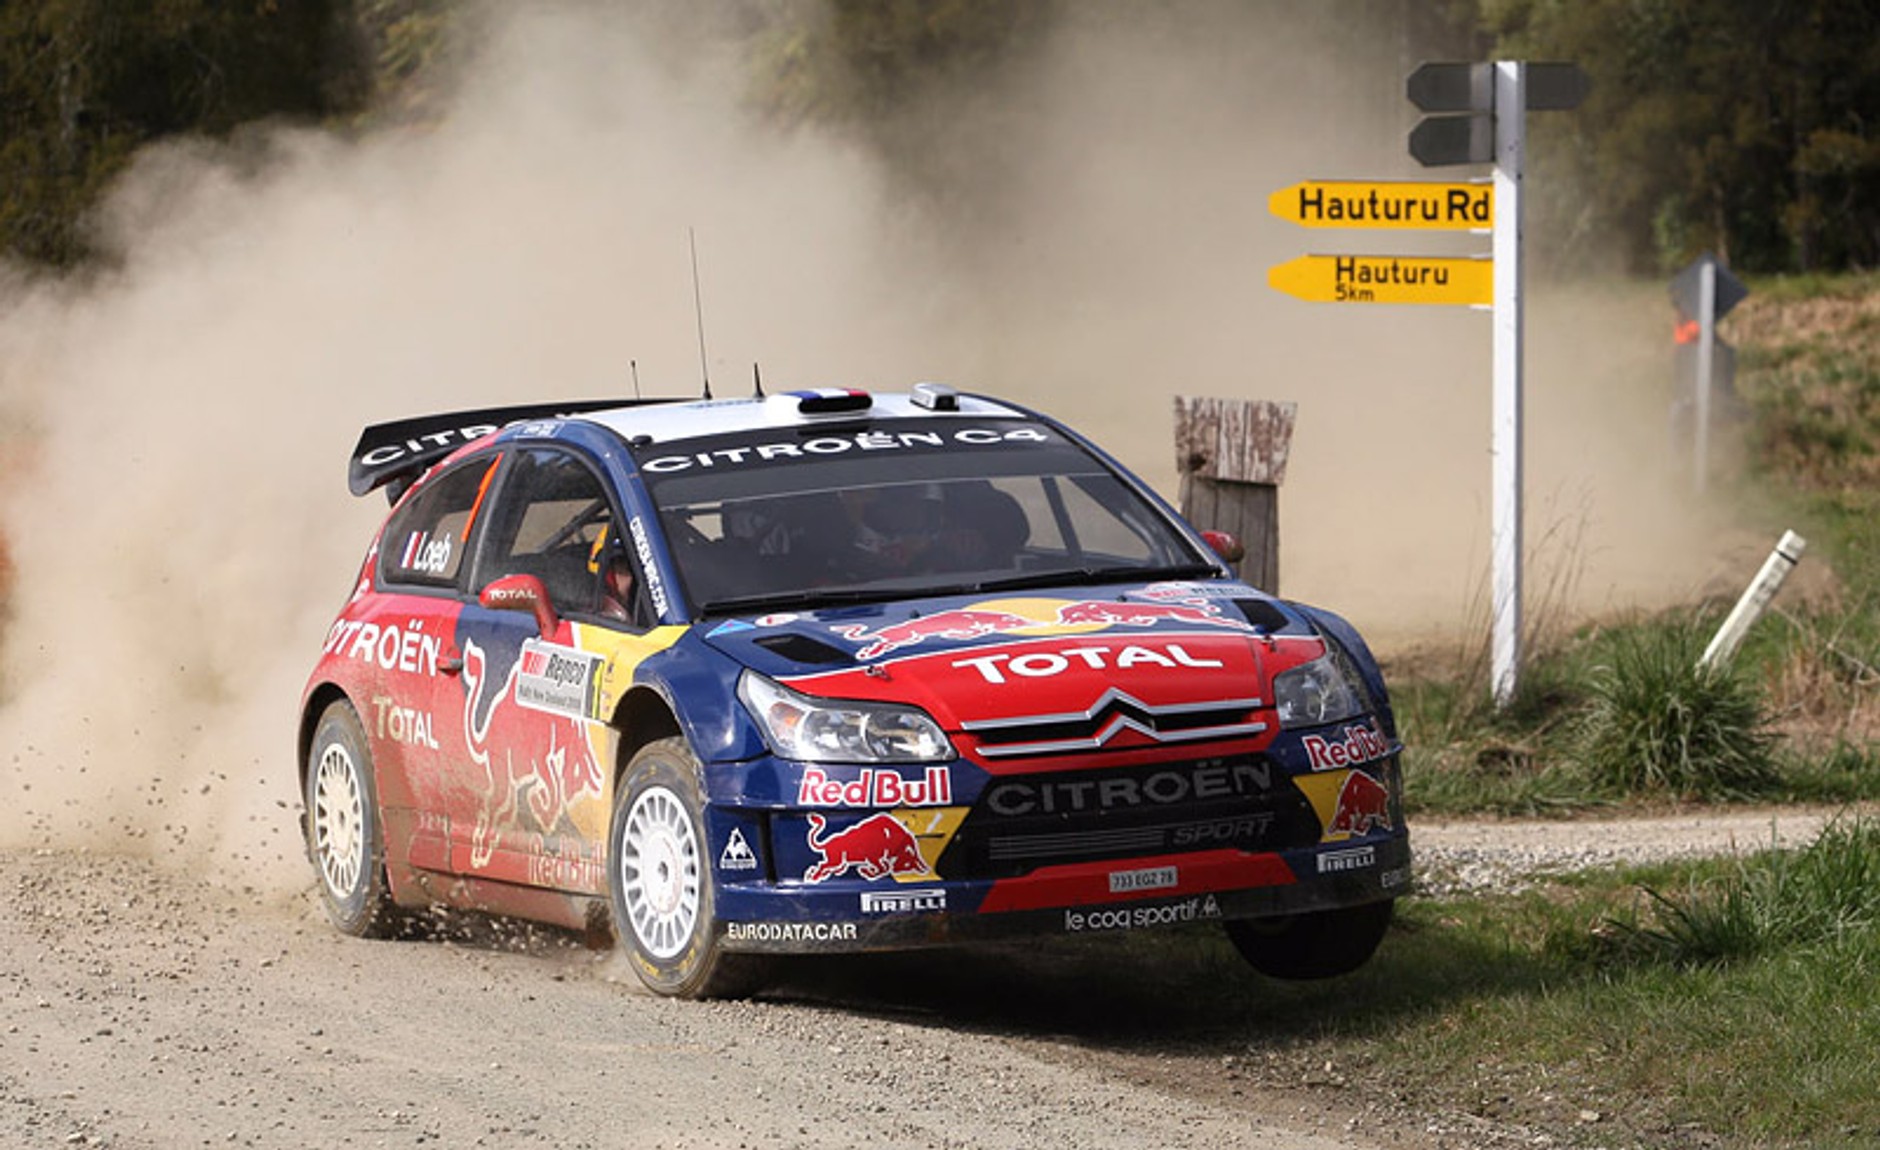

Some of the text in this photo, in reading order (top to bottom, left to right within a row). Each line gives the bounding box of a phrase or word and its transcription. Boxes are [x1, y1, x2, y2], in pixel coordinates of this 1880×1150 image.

[1299, 188, 1489, 221] Hauturu Rd
[1335, 257, 1448, 285] Hauturu
[1335, 284, 1374, 301] 5km
[642, 428, 1049, 473] CITROËN C4
[413, 531, 451, 573] Loeb
[489, 588, 537, 600] TOTAL
[545, 653, 587, 688] Repco
[951, 645, 1224, 684] TOTAL
[372, 695, 440, 749] TOTAL
[1302, 727, 1365, 771] Red
[797, 766, 952, 807] Red Bull
[988, 760, 1272, 815] CITROËN
[1172, 814, 1275, 846] SPORT
[1317, 847, 1376, 873] PIRELLI
[860, 889, 946, 913] PIRELLI
[1065, 898, 1199, 931] le coq sportif
[727, 922, 858, 942] EURODATACAR
